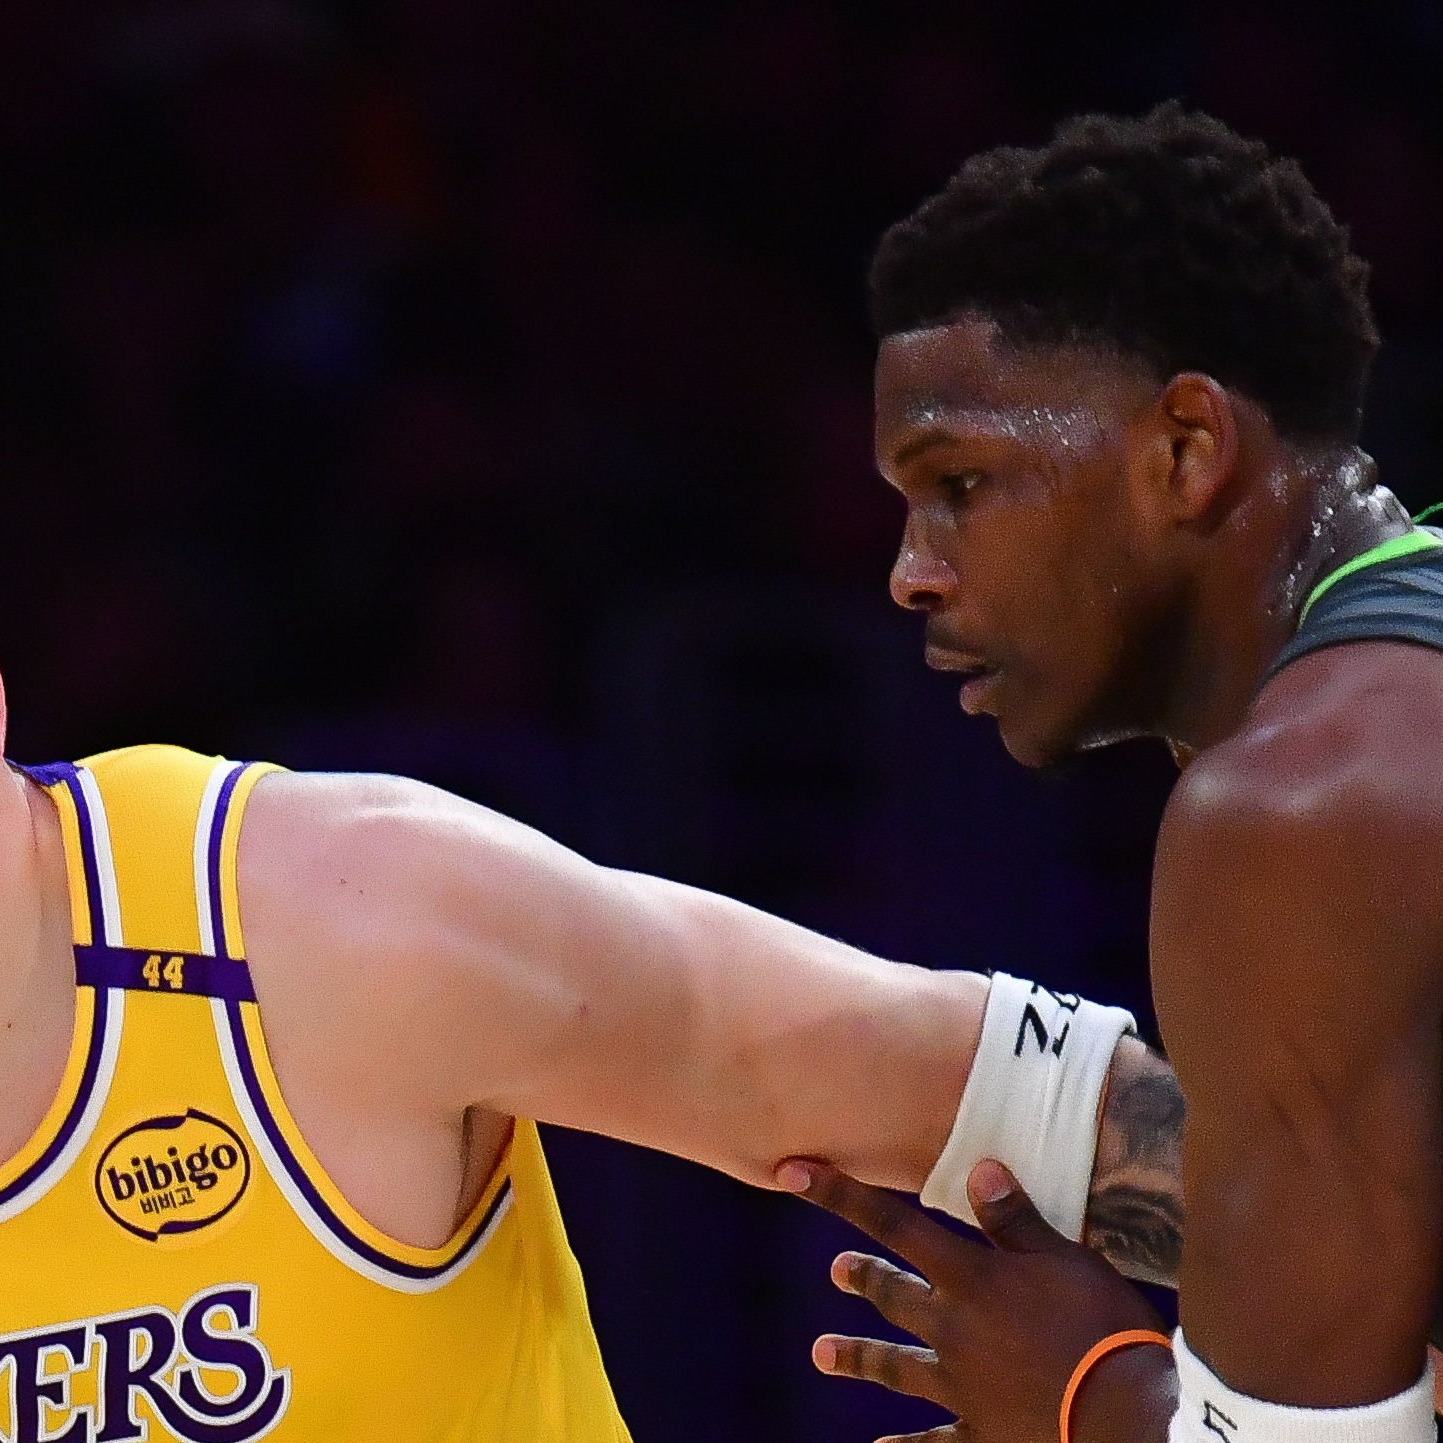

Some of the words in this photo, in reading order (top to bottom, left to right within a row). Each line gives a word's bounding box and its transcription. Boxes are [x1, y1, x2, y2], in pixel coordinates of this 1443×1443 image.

[142, 955, 185, 988] 44
[106, 1143, 238, 1201] bibigo
[140, 1186, 195, 1214] 비비고
